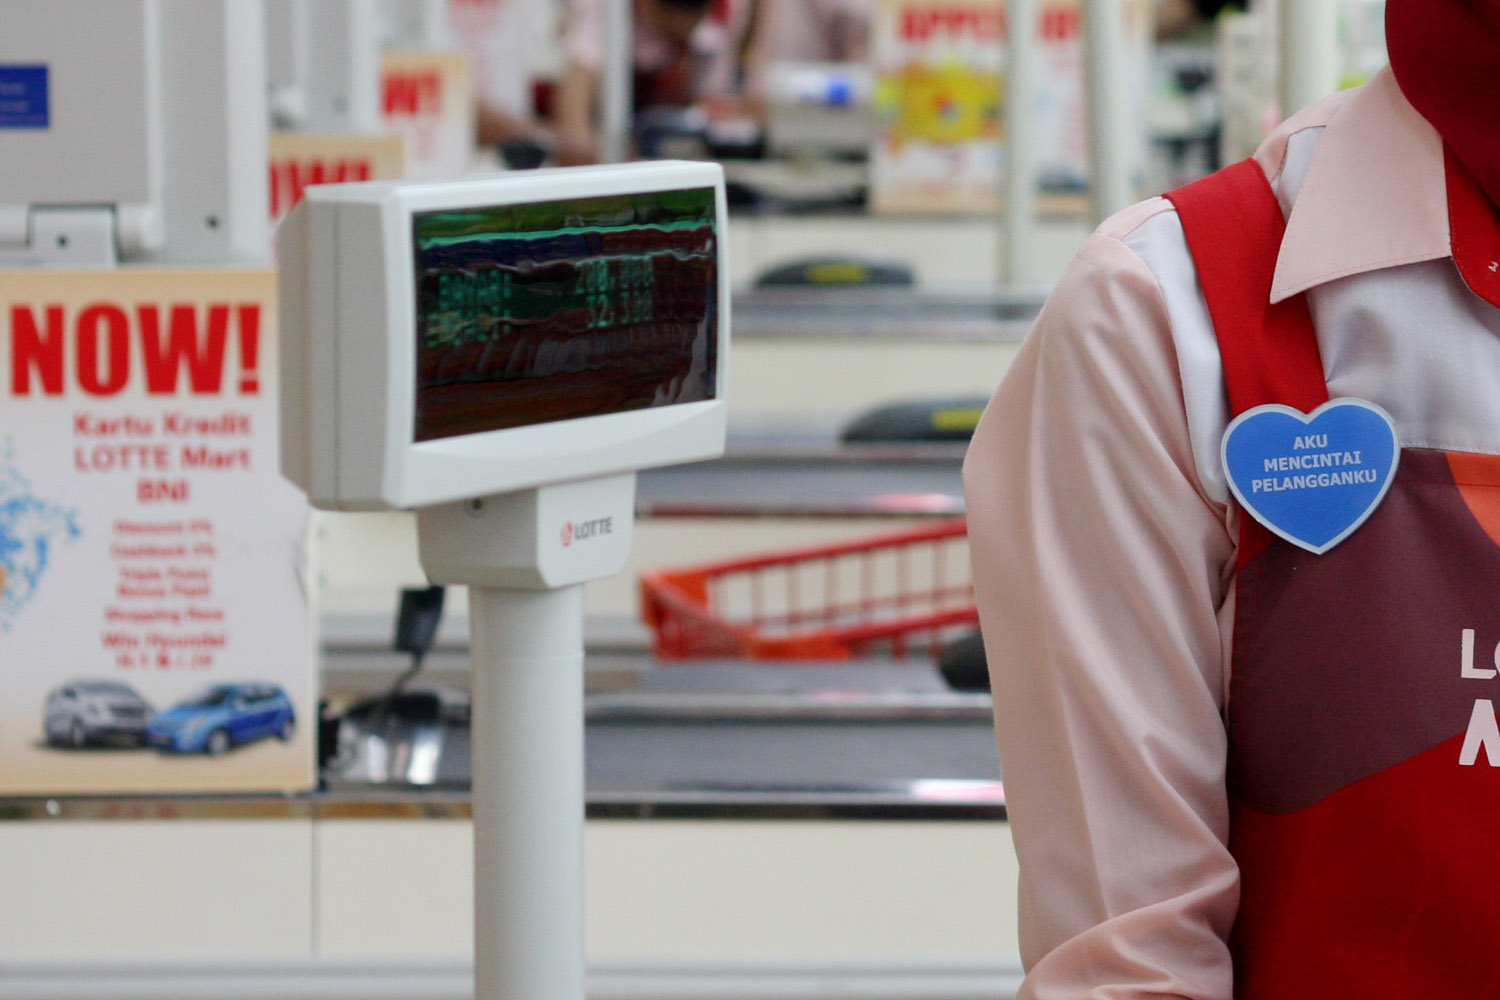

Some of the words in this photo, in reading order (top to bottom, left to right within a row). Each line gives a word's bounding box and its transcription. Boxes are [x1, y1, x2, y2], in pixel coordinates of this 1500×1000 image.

[11, 303, 261, 398] NOW!
[73, 412, 154, 436] Kartu
[162, 410, 251, 436] Kredit
[1293, 434, 1328, 450] AKU
[73, 446, 168, 471] LOTTE
[181, 445, 250, 470] Mart
[1263, 451, 1362, 472] MENCINTAI
[137, 478, 190, 502] BNI
[1252, 469, 1377, 493] PELANGGANKU
[574, 516, 613, 540] LOTTE
